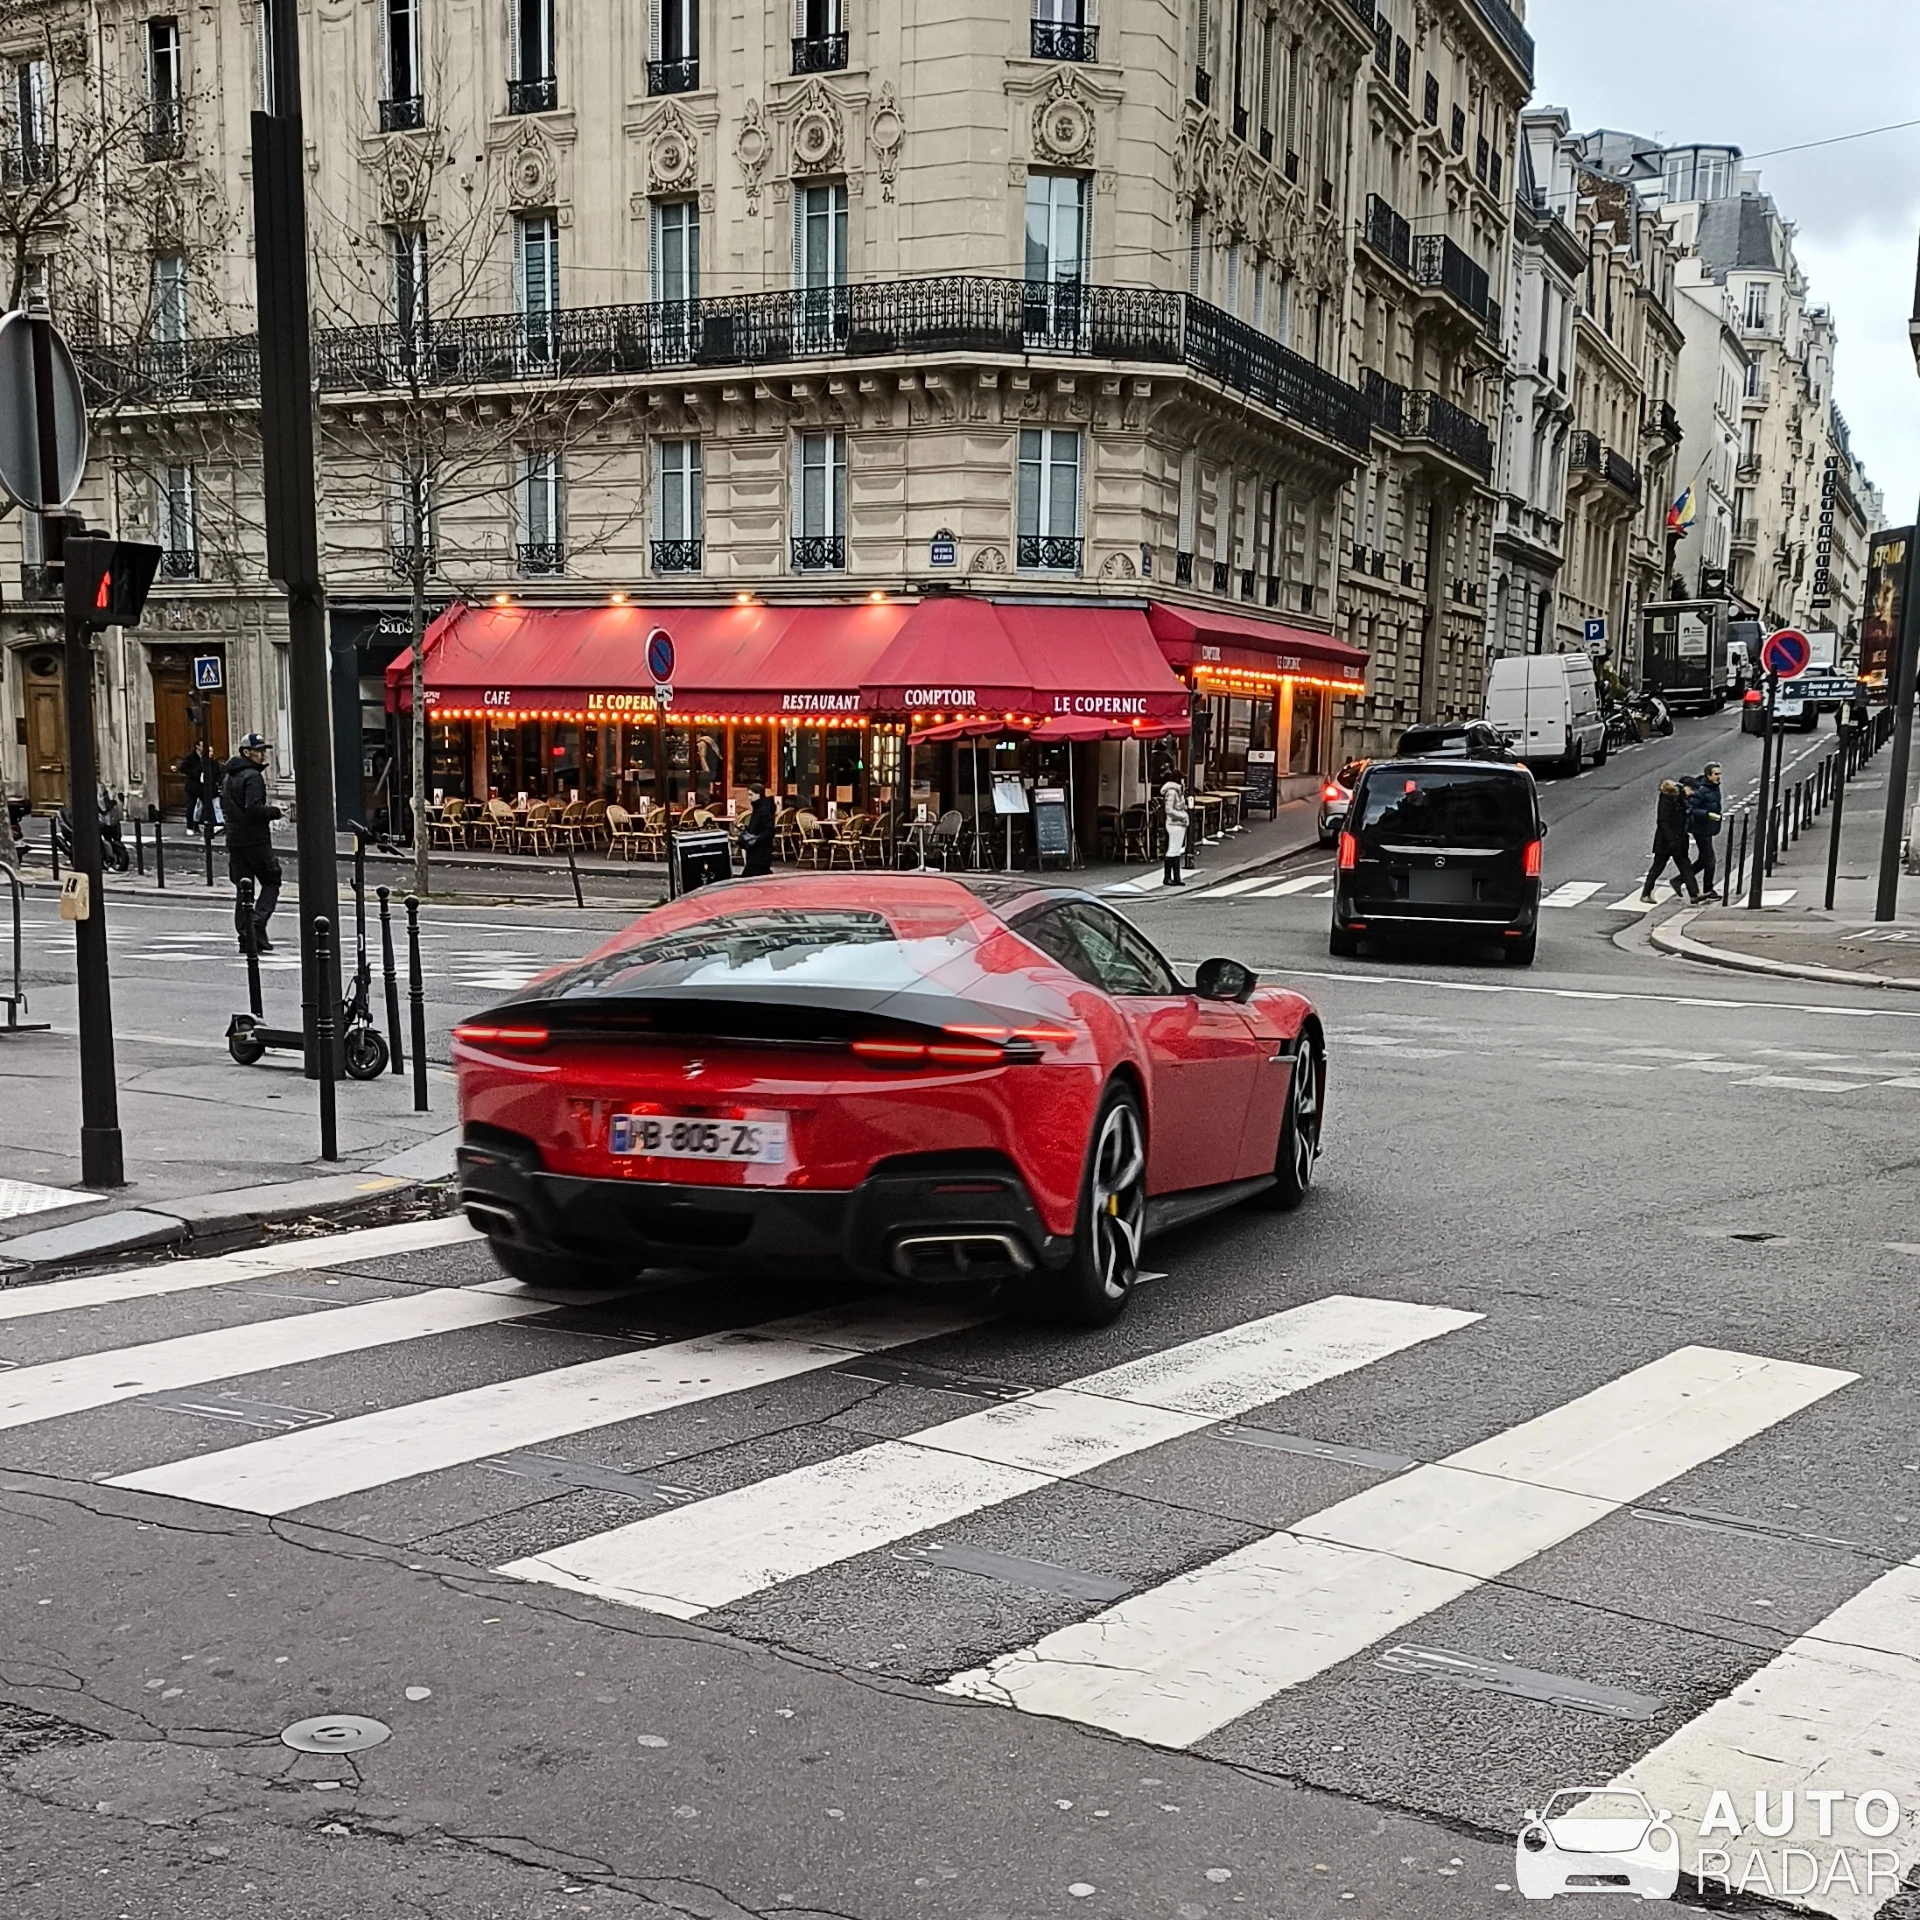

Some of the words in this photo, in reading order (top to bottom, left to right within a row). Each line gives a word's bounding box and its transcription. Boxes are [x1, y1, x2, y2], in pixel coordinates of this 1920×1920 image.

[1589, 623, 1600, 638] P
[483, 690, 512, 706] CAFE
[587, 693, 604, 710] LE
[606, 694, 672, 712] COPERNC
[781, 694, 861, 711] RESTAURANT
[904, 688, 977, 706] COMPTOIR
[1053, 695, 1071, 712] LE
[1074, 697, 1148, 713] COPERNIC
